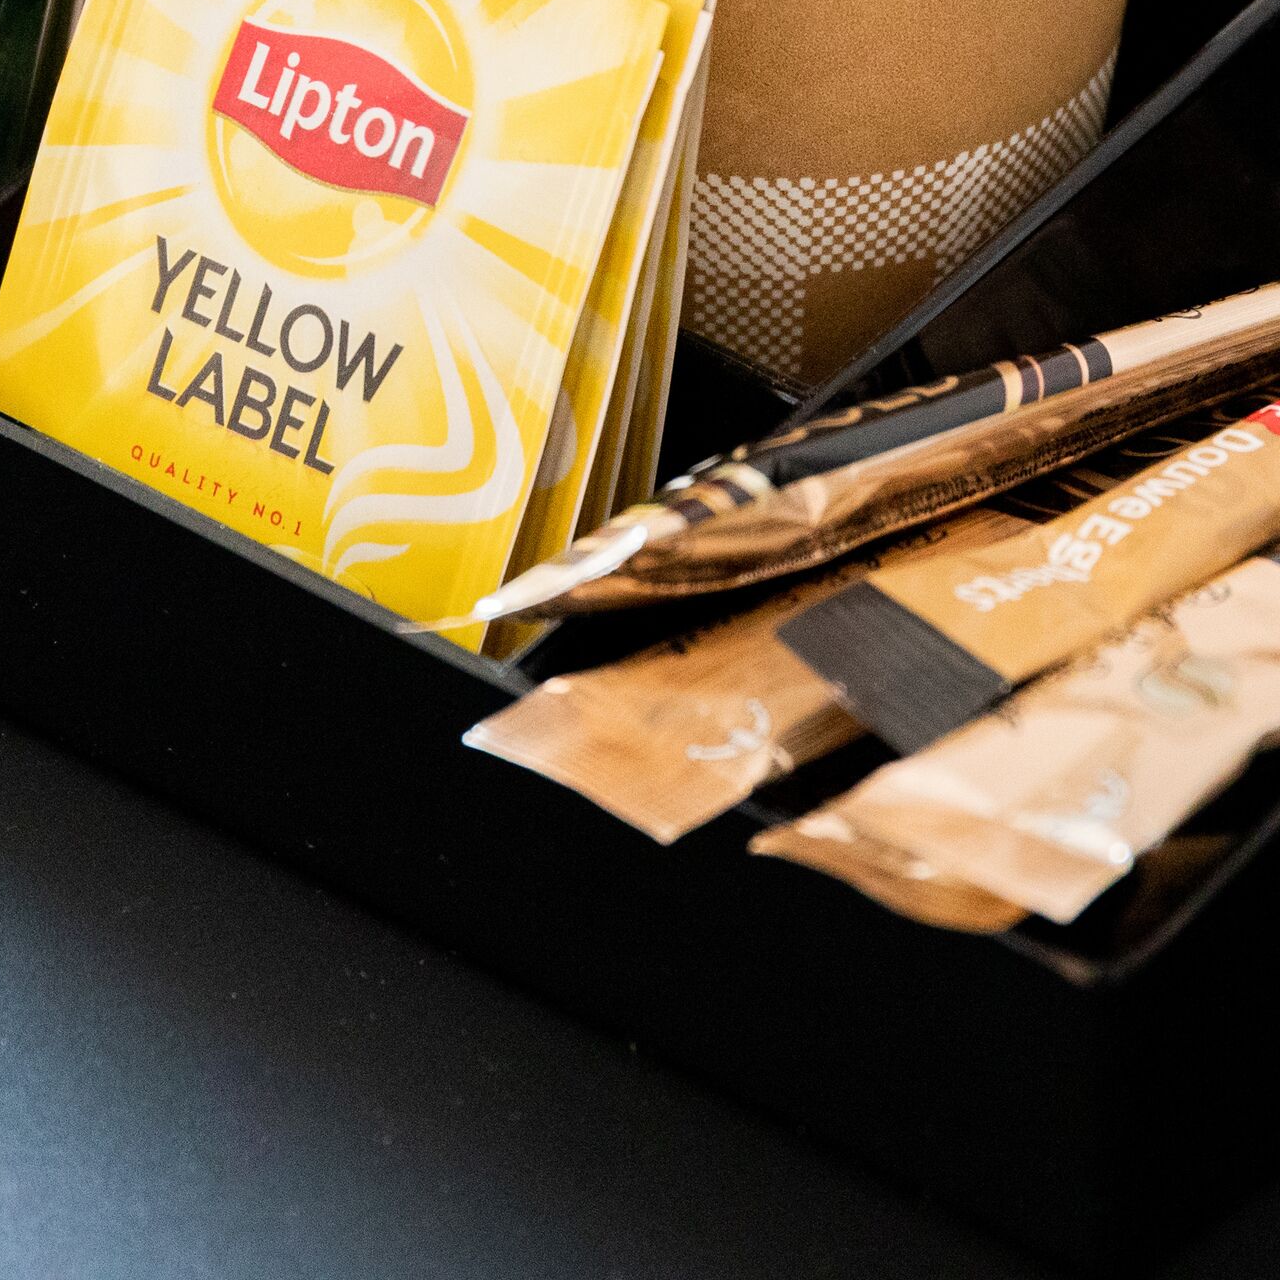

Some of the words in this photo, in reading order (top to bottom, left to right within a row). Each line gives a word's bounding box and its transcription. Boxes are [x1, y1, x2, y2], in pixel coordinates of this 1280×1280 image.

[237, 40, 436, 180] Lipton
[149, 235, 404, 403] YELLOW
[147, 327, 335, 475] LABEL
[130, 443, 238, 505] QUALITY
